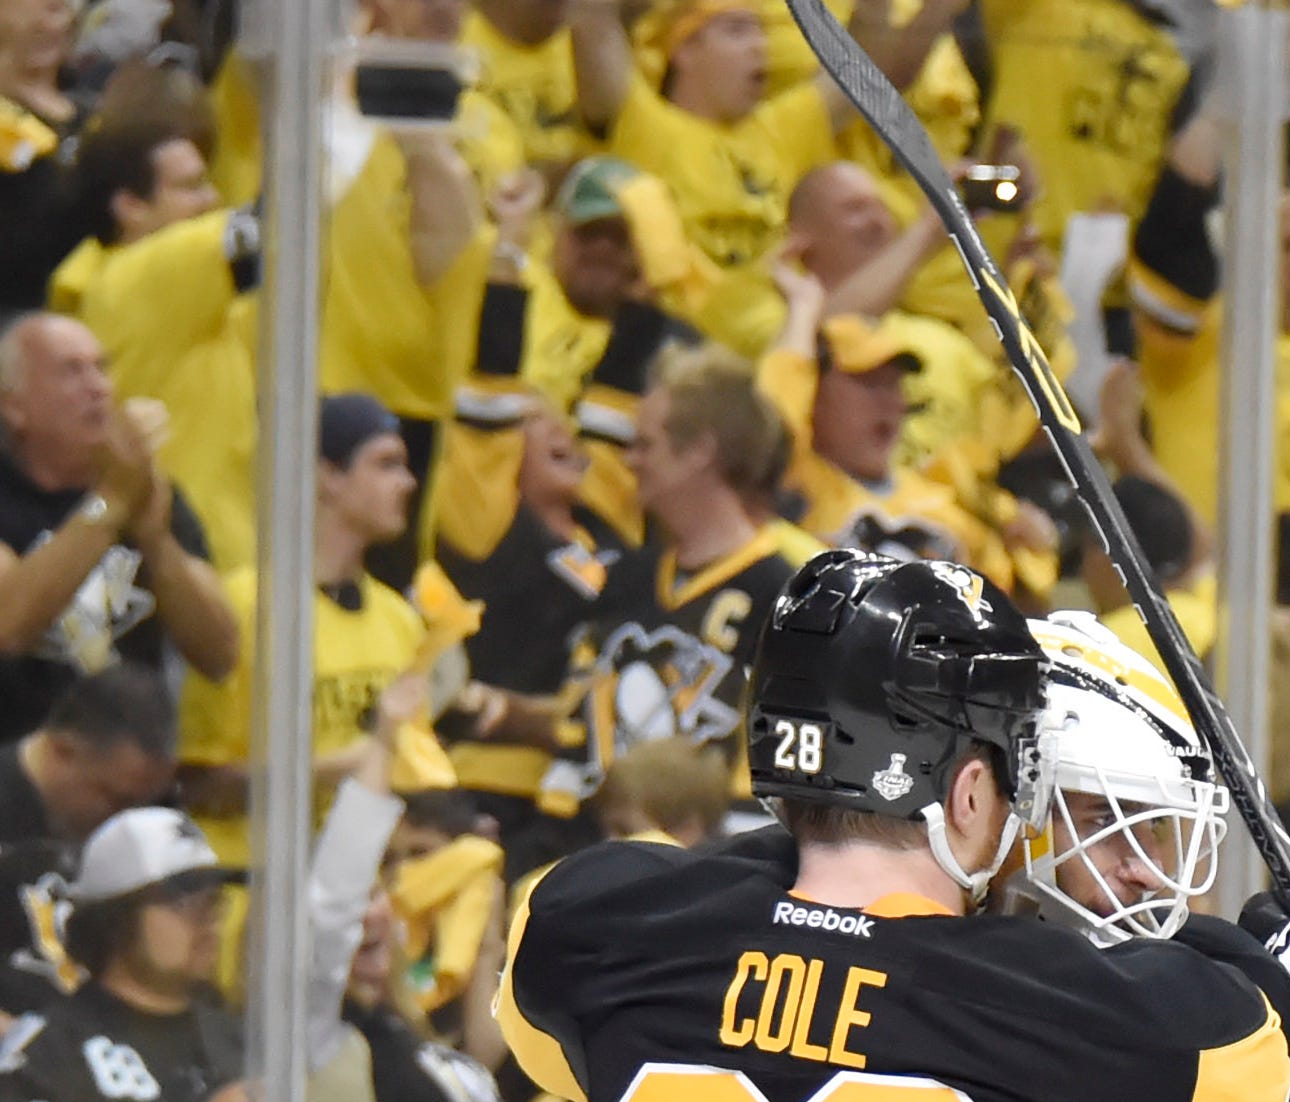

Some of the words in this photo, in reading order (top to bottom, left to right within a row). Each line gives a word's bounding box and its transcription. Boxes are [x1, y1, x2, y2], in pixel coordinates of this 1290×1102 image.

[701, 587, 753, 653] C
[774, 719, 823, 775] 28
[772, 901, 876, 937] Reebok
[719, 951, 888, 1070] COLE
